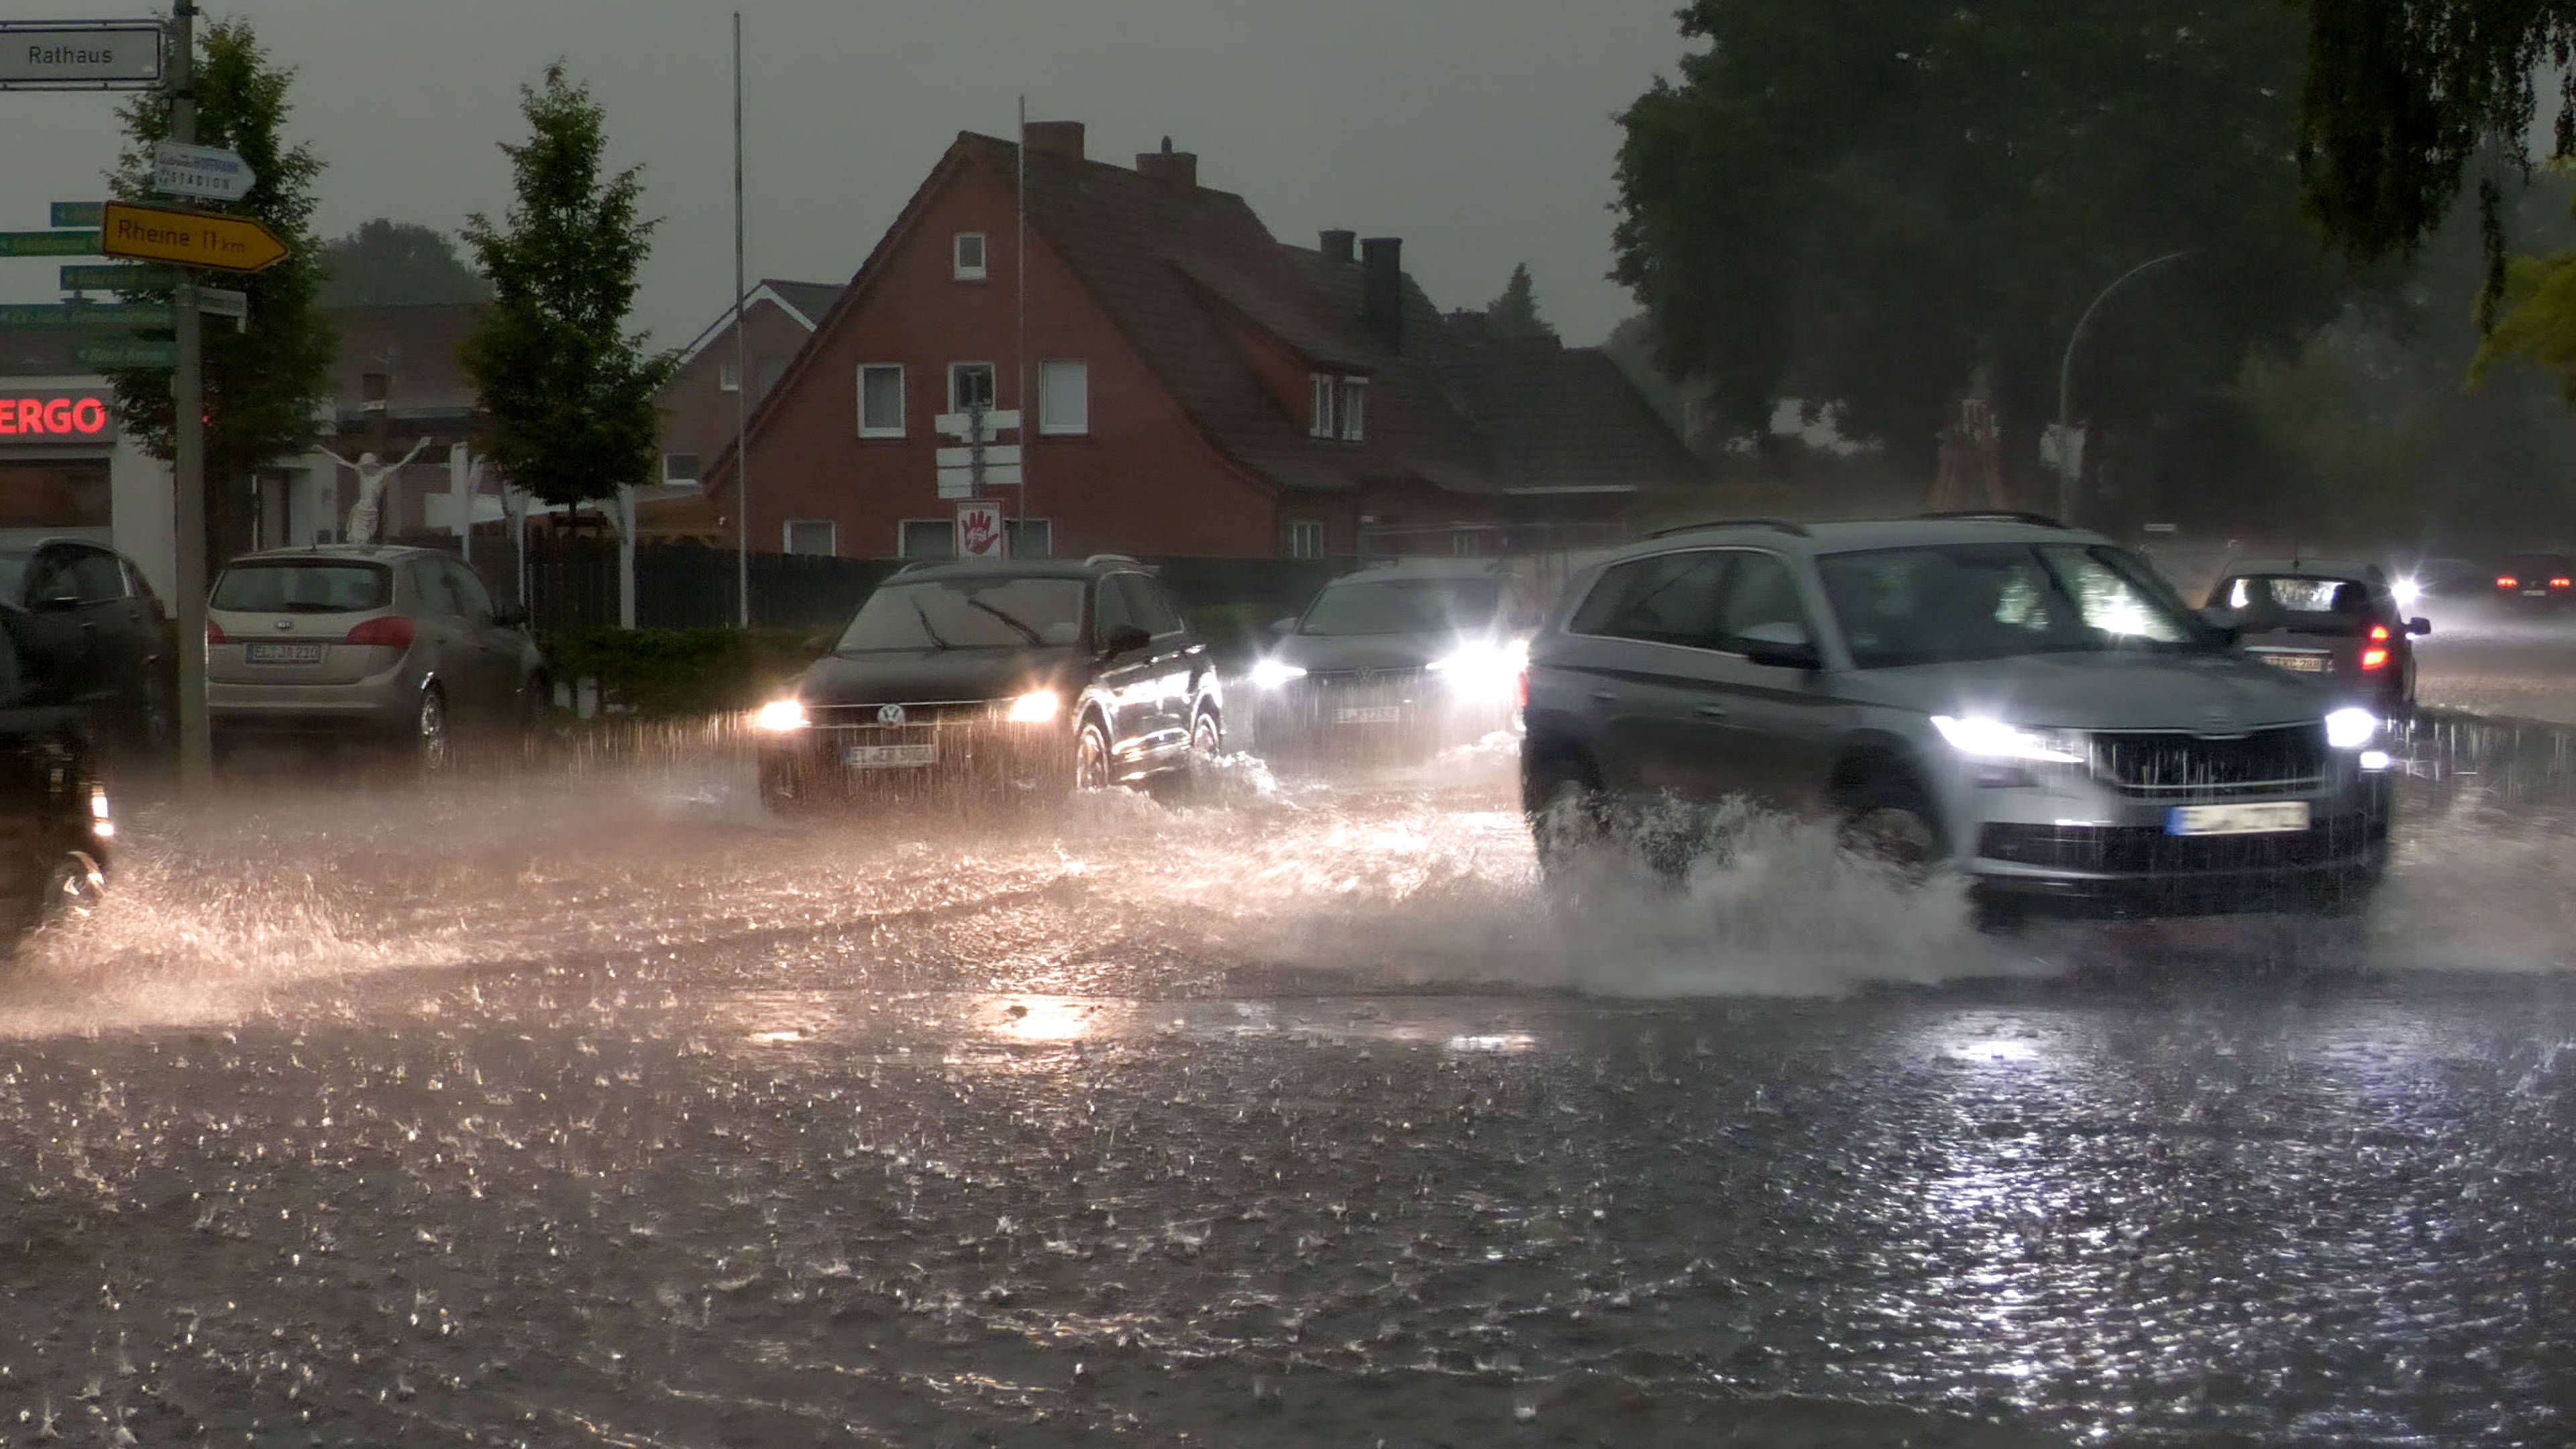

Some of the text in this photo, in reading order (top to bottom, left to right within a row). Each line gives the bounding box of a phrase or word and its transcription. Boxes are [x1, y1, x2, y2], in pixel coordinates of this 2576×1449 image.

[29, 46, 113, 64] Rathaus
[170, 171, 231, 190] STADION
[117, 219, 191, 247] Rheine
[203, 231, 217, 251] 11
[222, 239, 246, 254] km
[0, 398, 106, 434] ERGO
